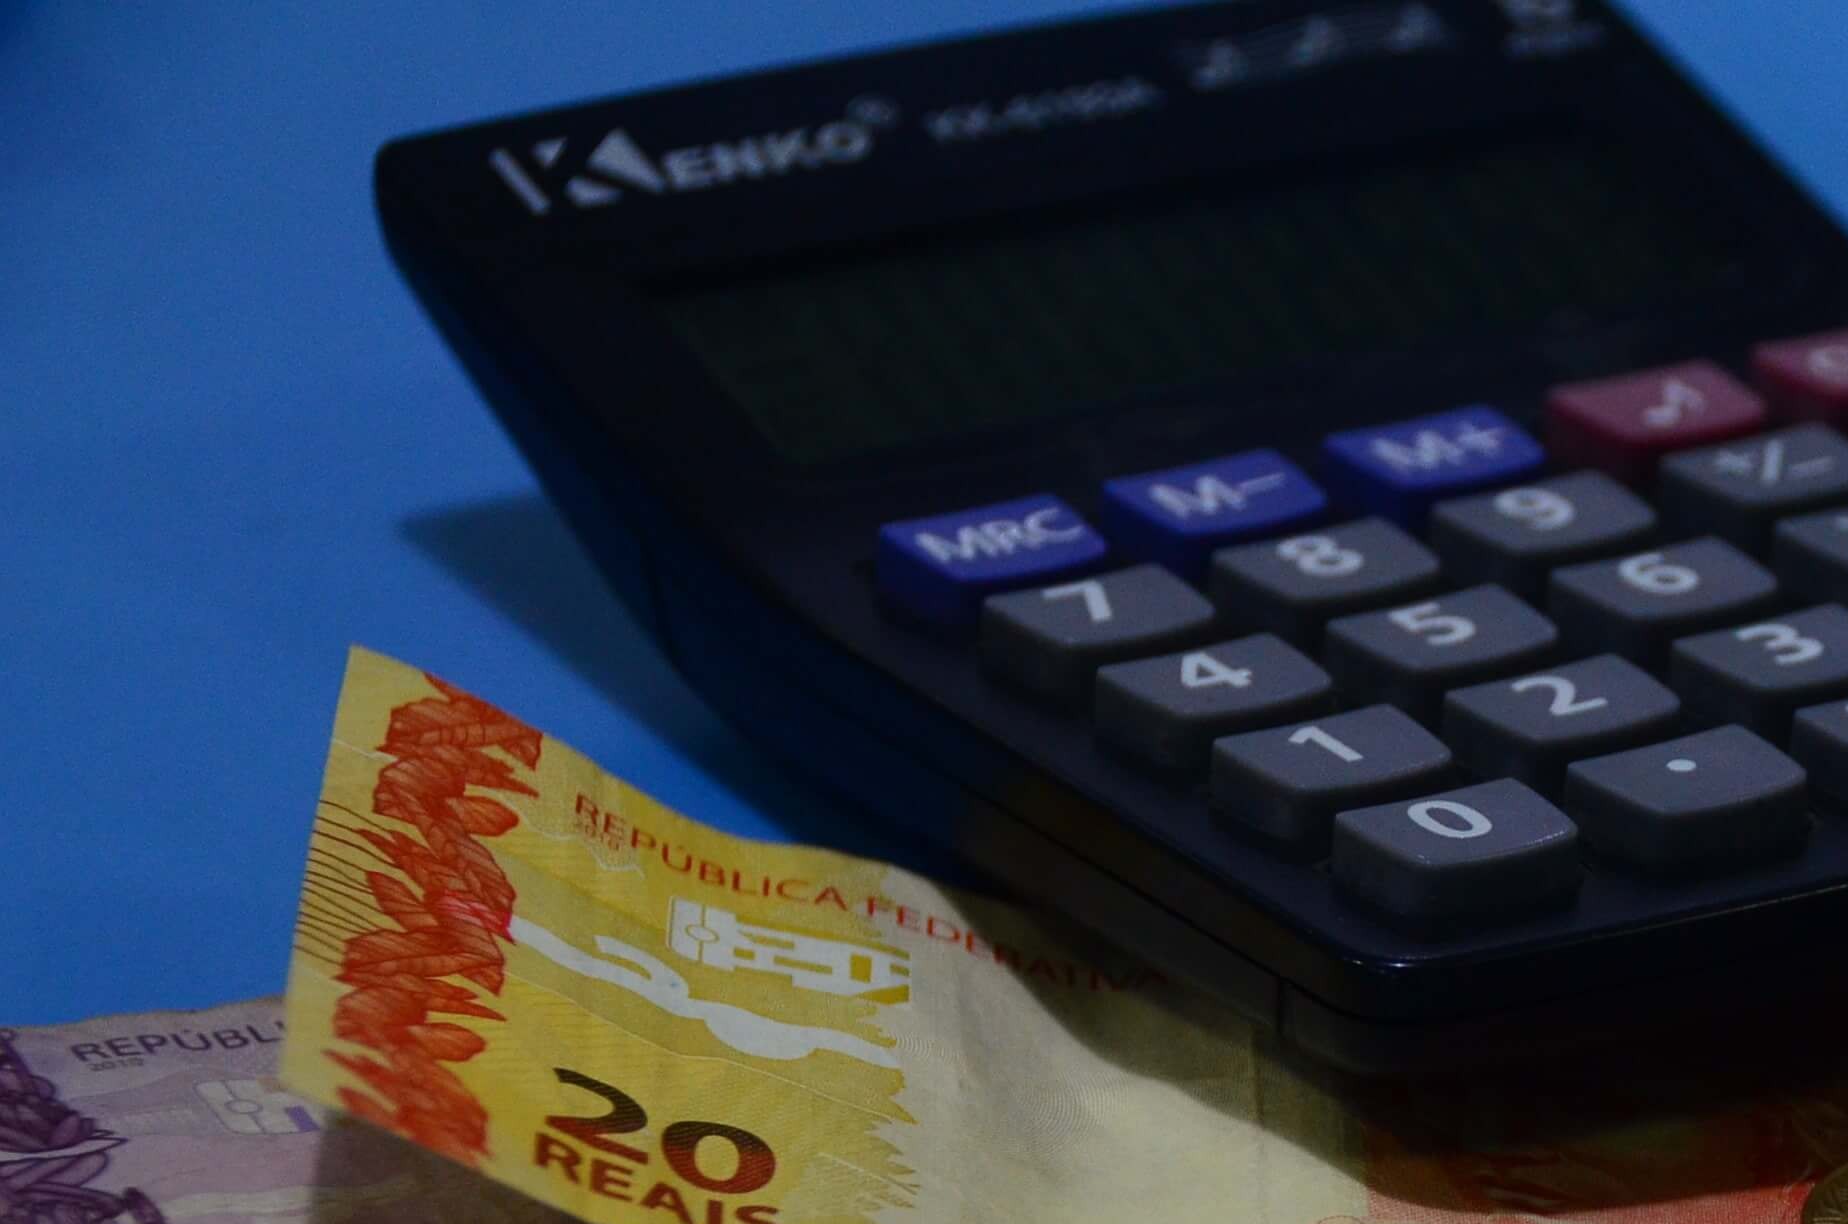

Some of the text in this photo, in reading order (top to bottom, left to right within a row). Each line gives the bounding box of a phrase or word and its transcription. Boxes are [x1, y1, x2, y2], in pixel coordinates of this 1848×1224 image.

[488, 119, 874, 217] KENKO
[1368, 423, 1505, 472] M+
[1495, 487, 1575, 530] 9
[914, 505, 1084, 564] MRC
[1277, 535, 1364, 577] 8
[1618, 552, 1699, 594] 6
[1043, 578, 1113, 622] 7
[1388, 603, 1477, 646] 5
[1736, 623, 1824, 664] 3
[1180, 651, 1253, 689] 4
[1512, 675, 1607, 716] 2
[1288, 724, 1363, 763] 1
[1407, 799, 1493, 839] 0
[576, 794, 1170, 993] REPÚBLICA FEDERATIVA
[70, 1020, 285, 1061] REPÚBL
[545, 1067, 776, 1194] 20
